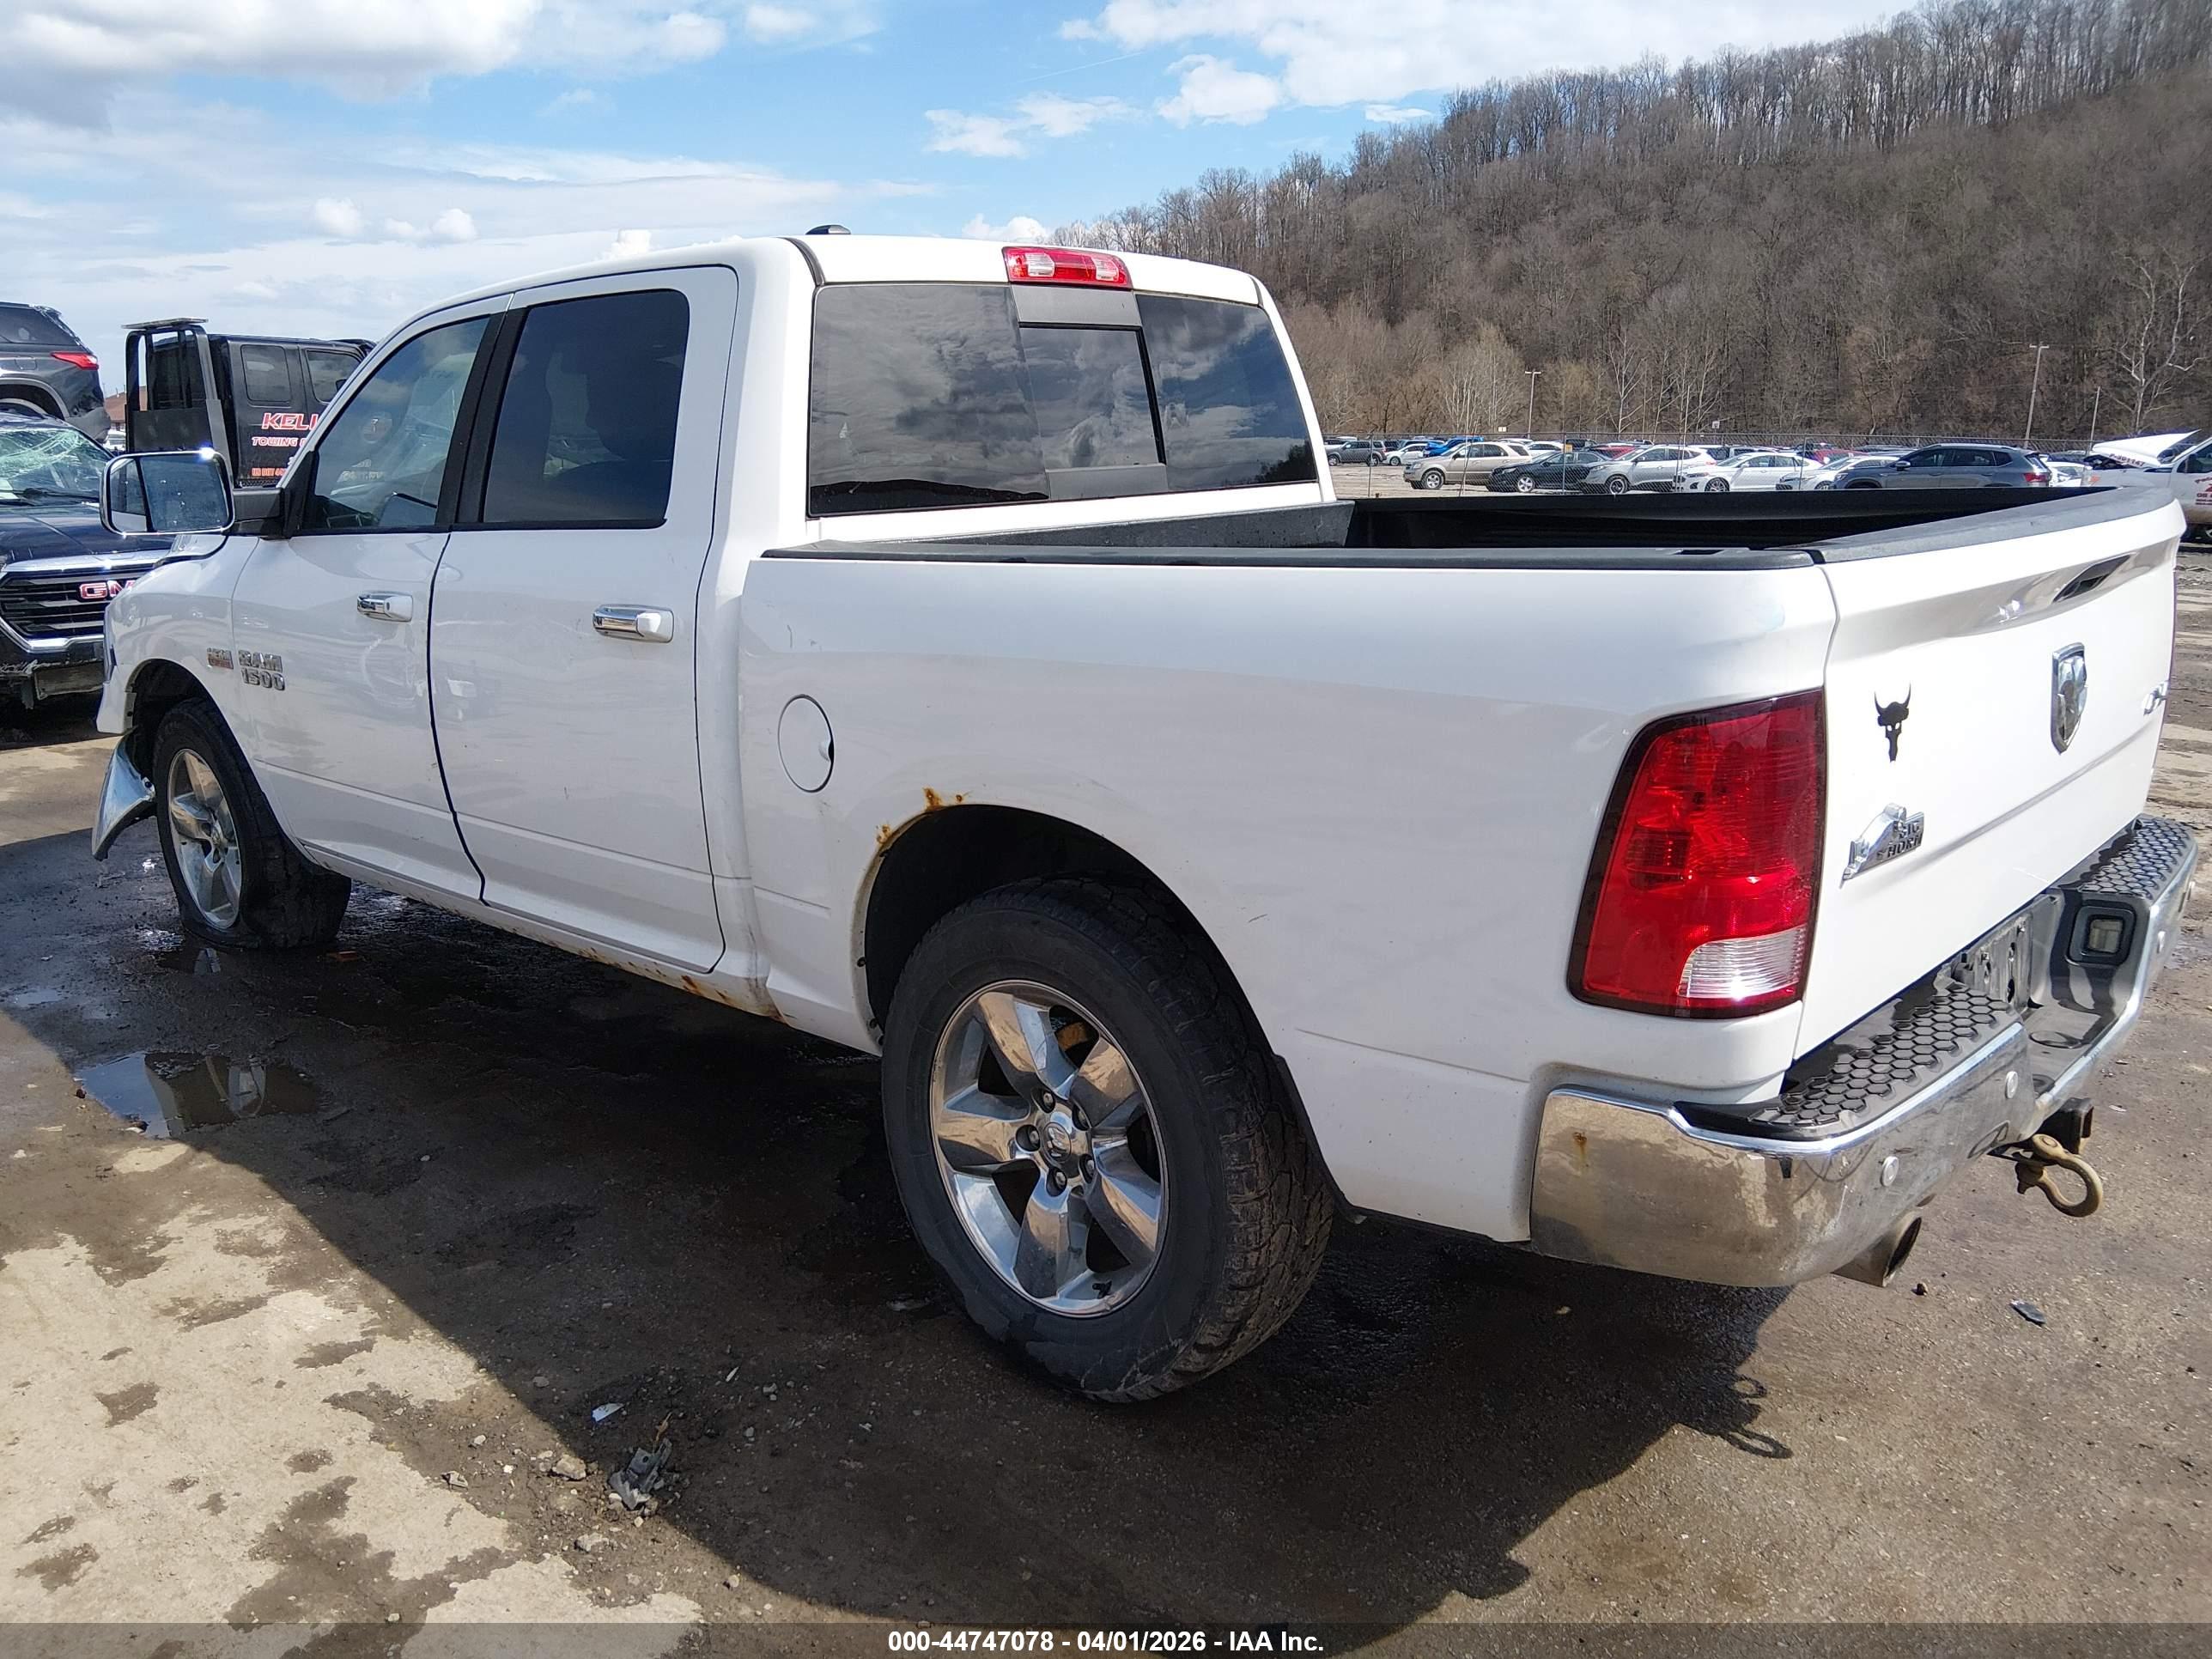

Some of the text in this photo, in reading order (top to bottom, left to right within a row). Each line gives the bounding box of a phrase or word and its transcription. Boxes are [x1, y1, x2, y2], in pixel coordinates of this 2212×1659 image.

[251, 436, 299, 447] TOWING
[238, 649, 283, 673] RAM
[241, 667, 286, 691] 1500
[1887, 832, 1923, 858] HORN
